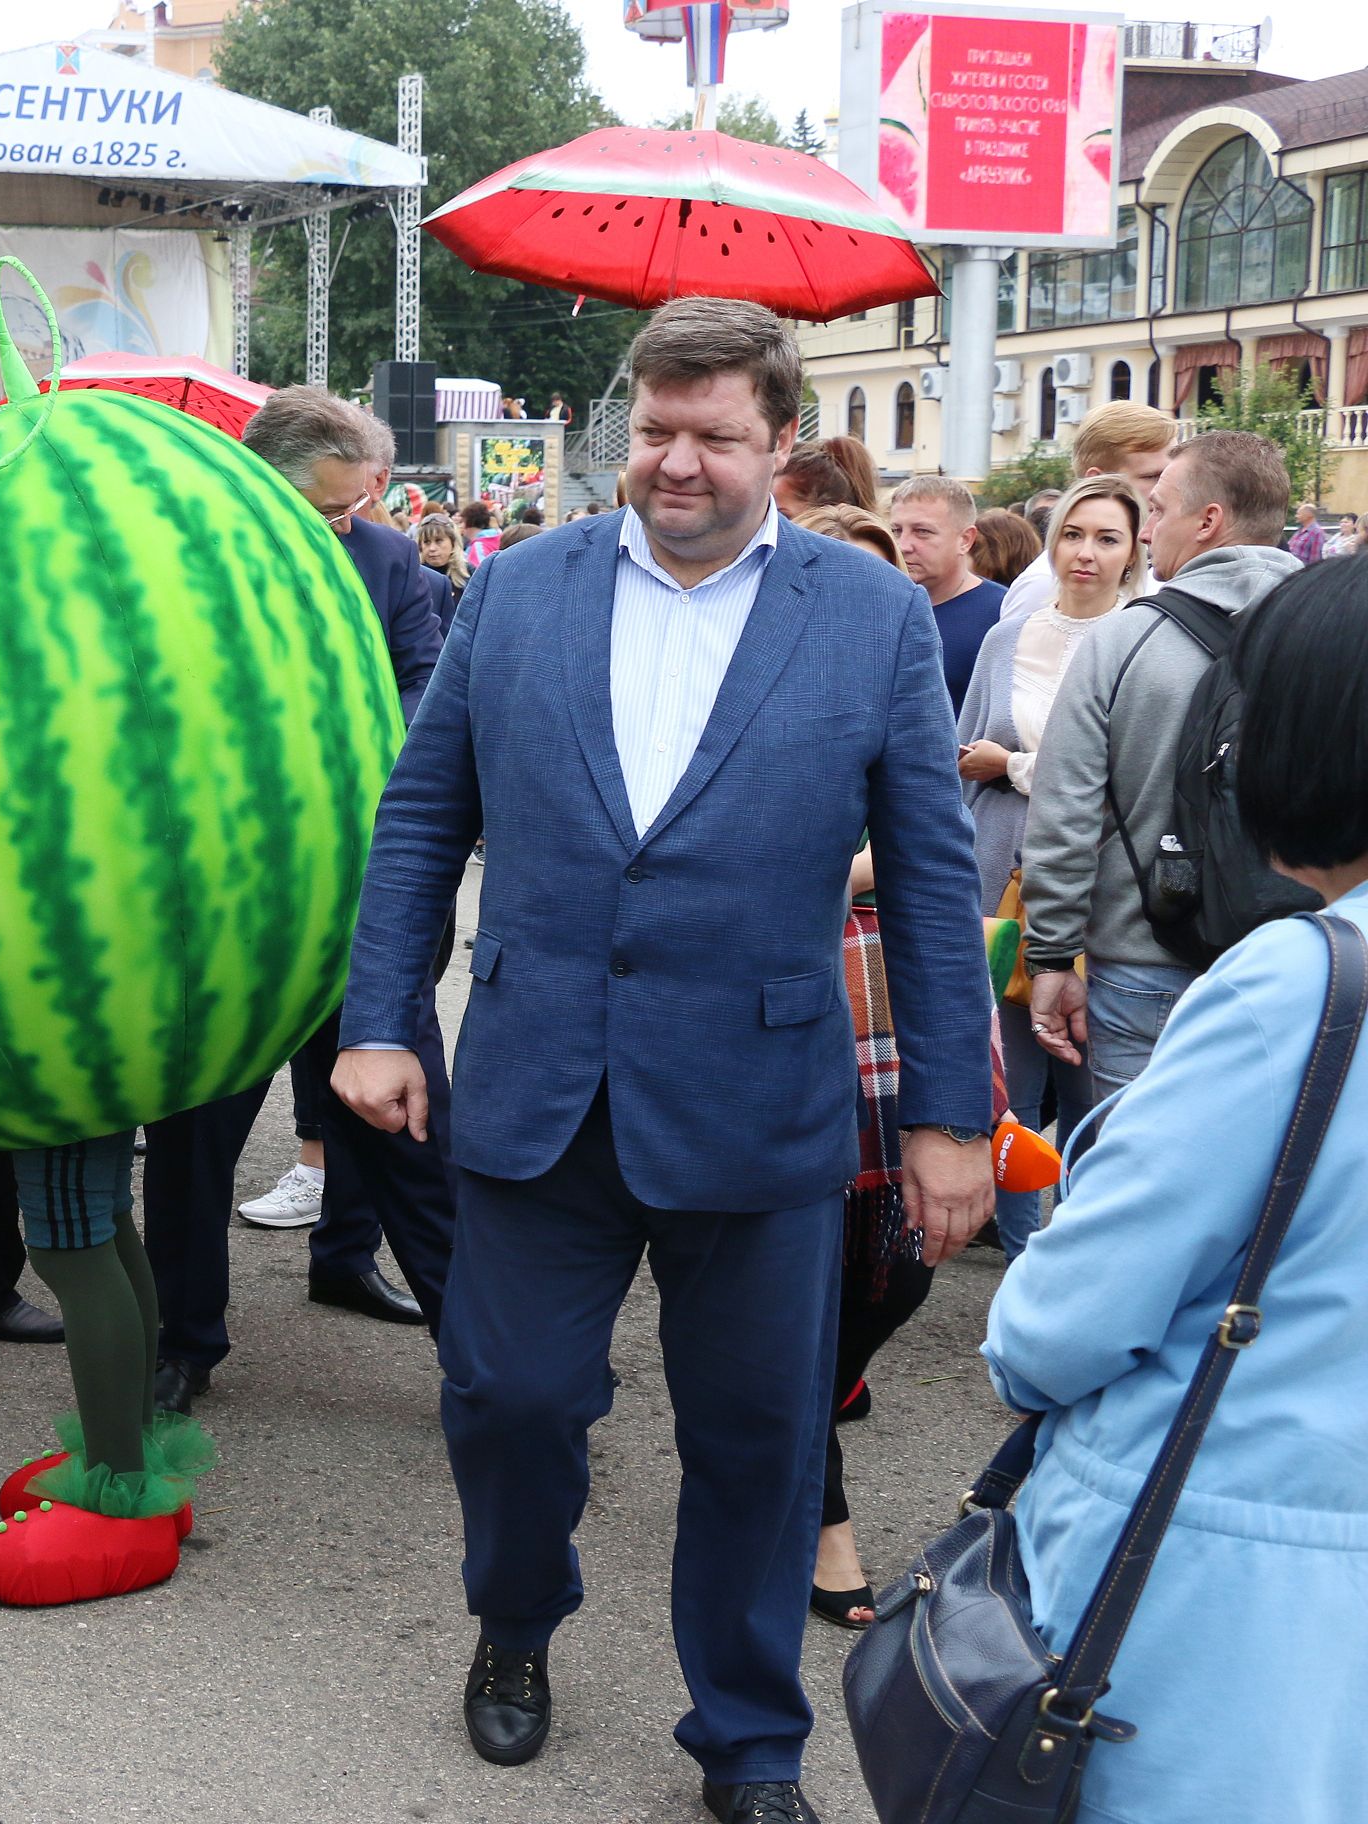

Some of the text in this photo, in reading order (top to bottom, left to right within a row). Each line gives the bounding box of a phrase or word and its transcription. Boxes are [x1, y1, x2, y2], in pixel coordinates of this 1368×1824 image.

[968, 49, 1032, 66] ПРИГЛАШАЕМ
[951, 71, 1049, 91] ЖИТЕЛЕЙ И ГОСТЕЙ
[929, 92, 1067, 114] СТАВРОПОЛЬСКОГО КРАЯ
[955, 116, 1041, 136] ПРИНЯТЬ УЧАСТИЕ
[165, 149, 188, 169] г.
[964, 140, 1029, 158] В ПРАЗДНИКЕ
[959, 166, 1032, 185] «АРБУЗНИК»
